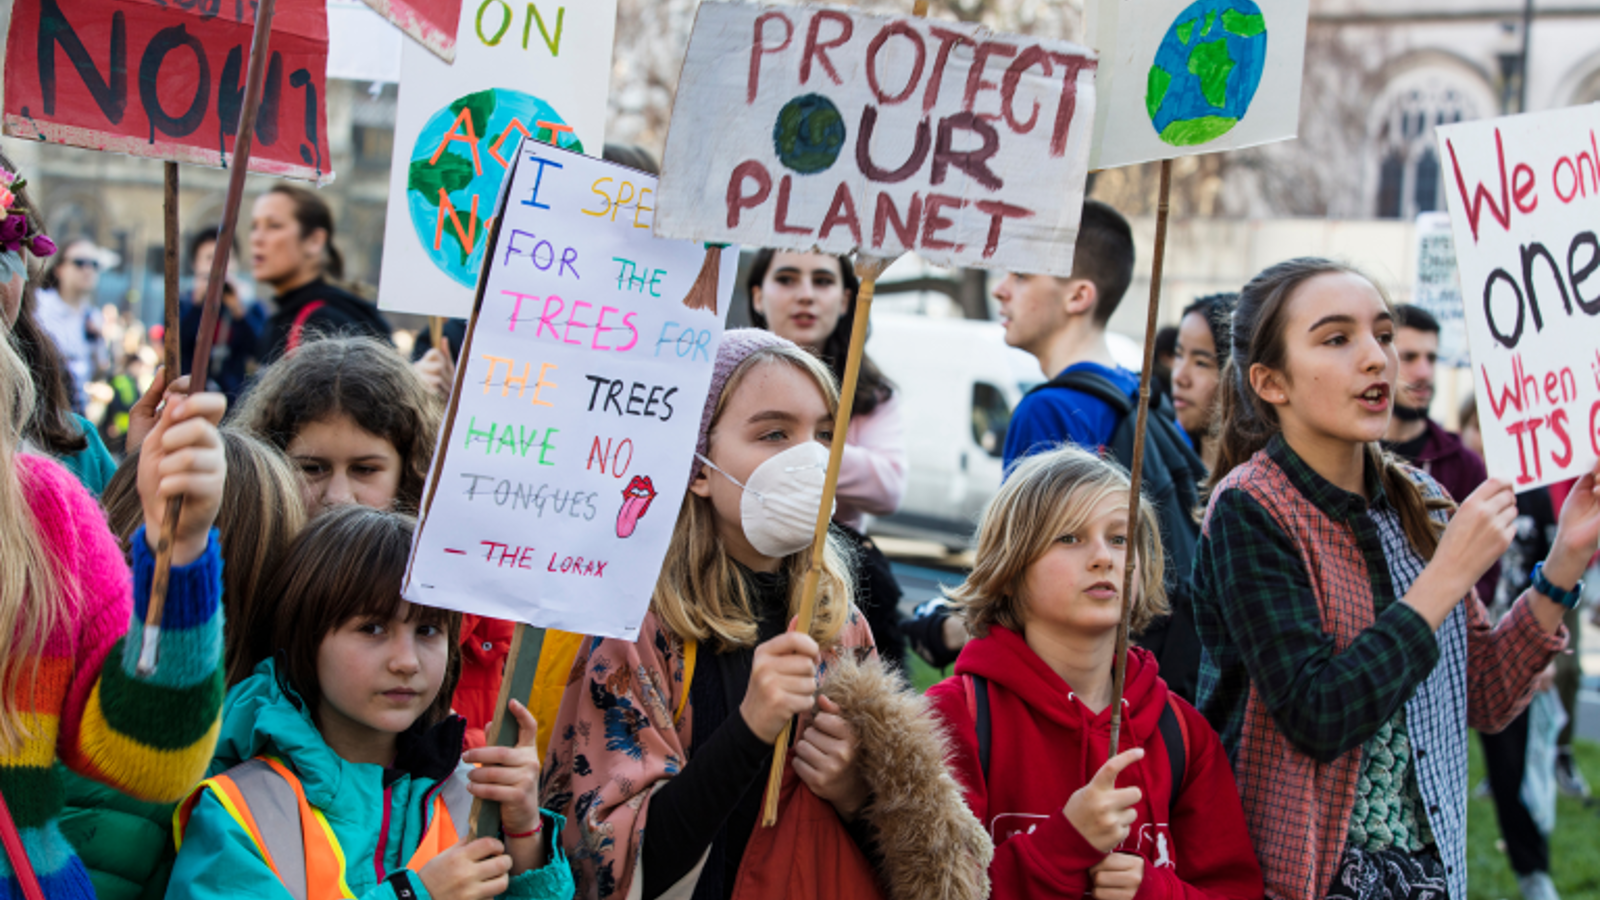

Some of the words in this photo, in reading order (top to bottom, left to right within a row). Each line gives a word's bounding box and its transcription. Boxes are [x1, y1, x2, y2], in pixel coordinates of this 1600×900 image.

[475, 0, 565, 57] ON
[747, 10, 1098, 158] PROTECT
[521, 156, 563, 210] I
[726, 159, 1035, 259] PLANET
[1446, 127, 1538, 244] We
[434, 187, 492, 255] N
[503, 229, 580, 279] FOR
[612, 257, 667, 297] THE
[1483, 231, 1600, 349] one
[501, 290, 638, 351] TREES
[654, 321, 711, 362] FOR
[482, 354, 558, 407] THE
[585, 374, 678, 421] TREES
[1482, 352, 1577, 420] When
[464, 416, 559, 466] HAVE
[587, 436, 634, 478] NO
[1505, 407, 1573, 485] IT'S
[461, 473, 598, 521] TONGUES
[480, 540, 535, 569] THE
[547, 552, 608, 577] LORAX
